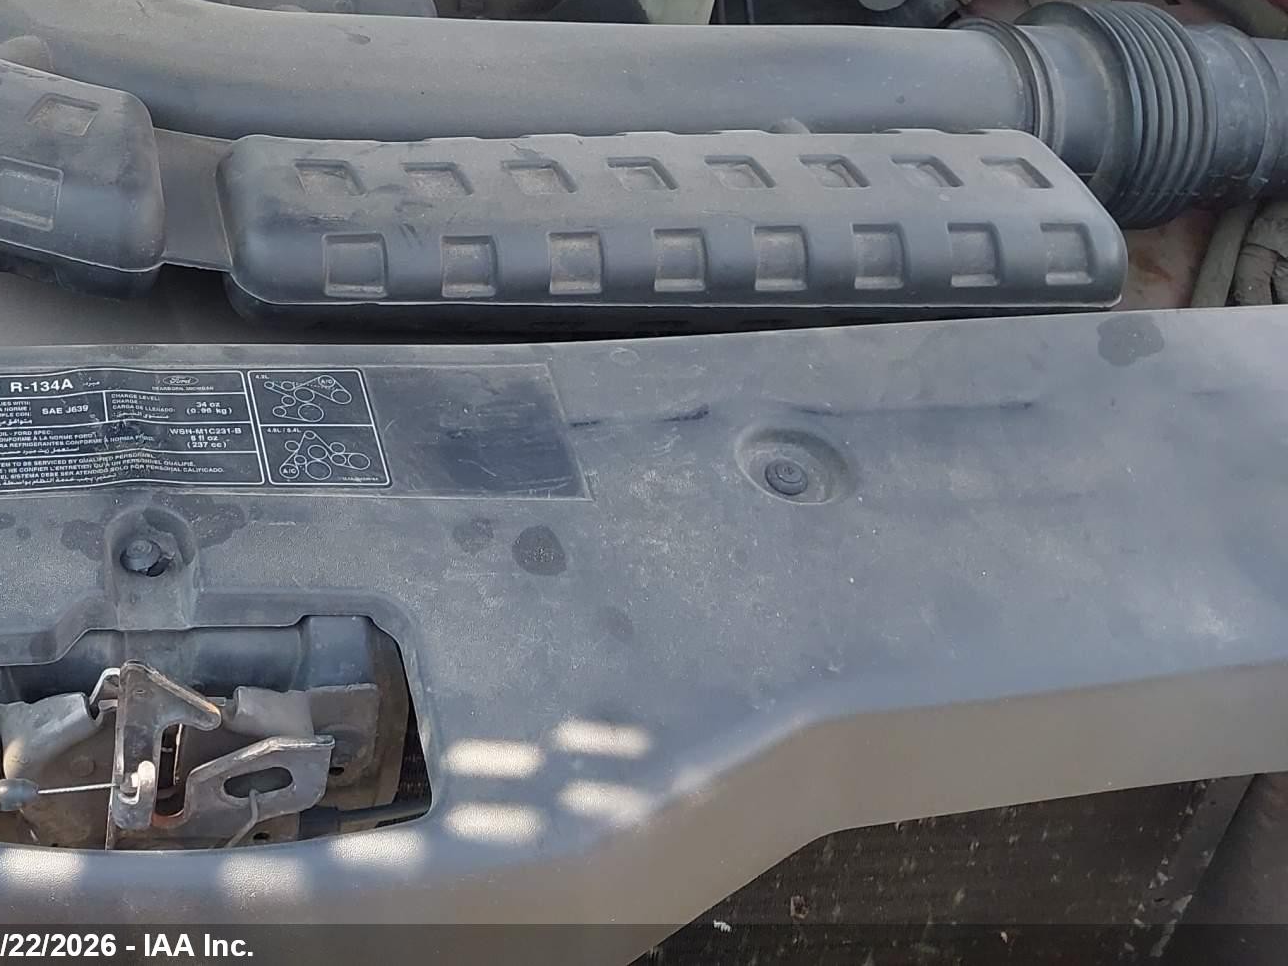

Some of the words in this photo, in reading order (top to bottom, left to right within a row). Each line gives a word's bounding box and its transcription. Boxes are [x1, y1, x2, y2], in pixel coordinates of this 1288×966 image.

[10, 379, 74, 393] R-134A
[169, 377, 192, 385] Ford
[41, 407, 63, 415] SAE
[65, 405, 89, 414] J639
